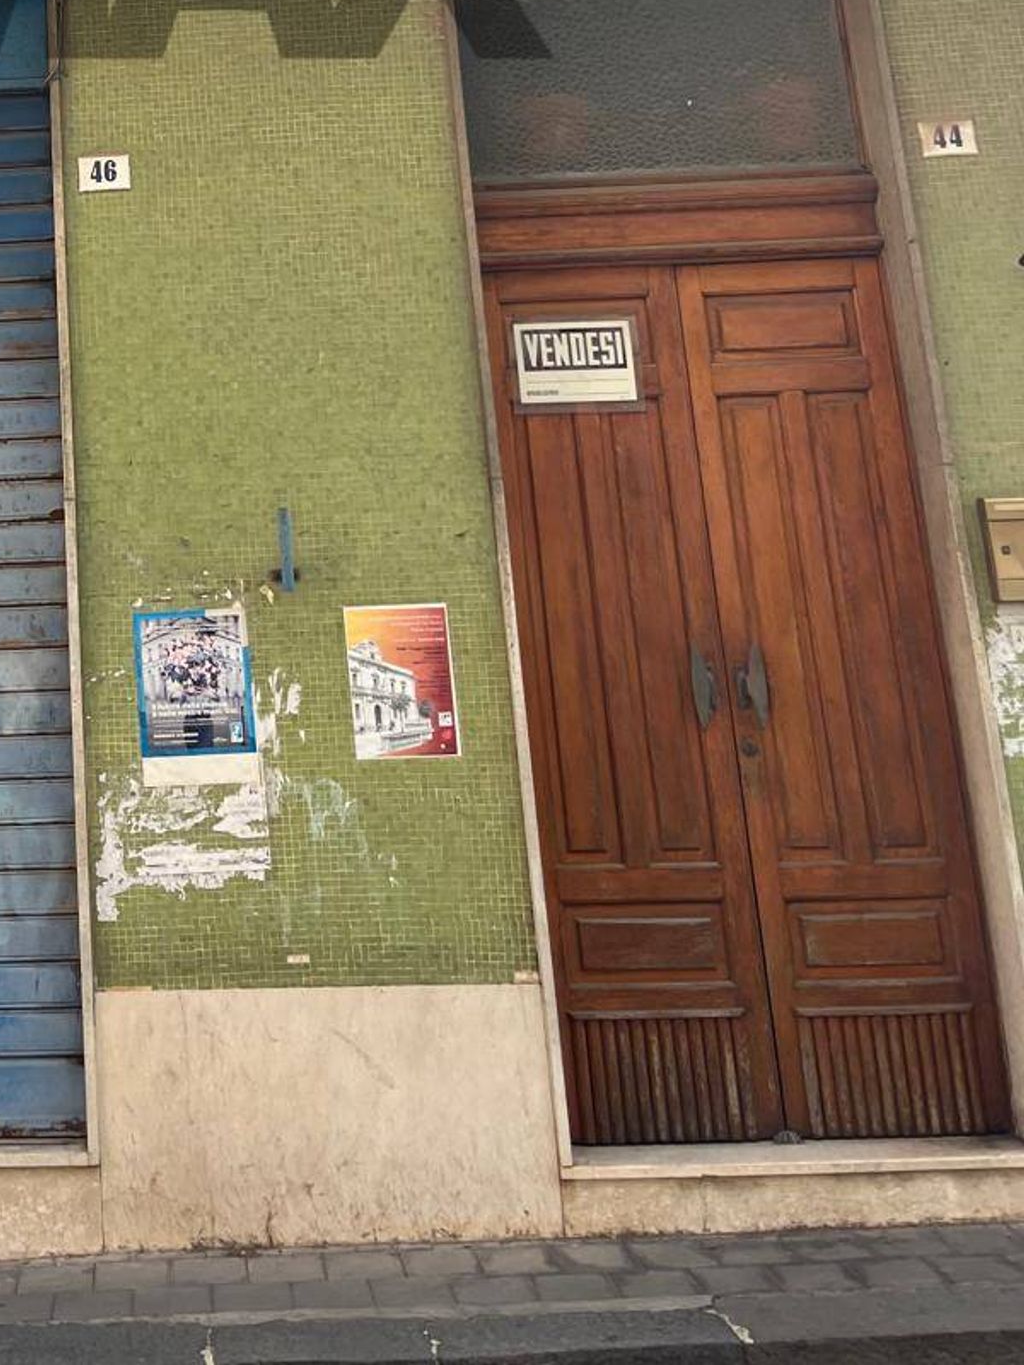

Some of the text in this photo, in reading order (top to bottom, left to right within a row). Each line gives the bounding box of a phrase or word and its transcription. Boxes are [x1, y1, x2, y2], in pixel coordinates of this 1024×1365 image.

[933, 123, 963, 148] 44
[90, 160, 117, 183] 46
[524, 330, 624, 368] VENDESI
